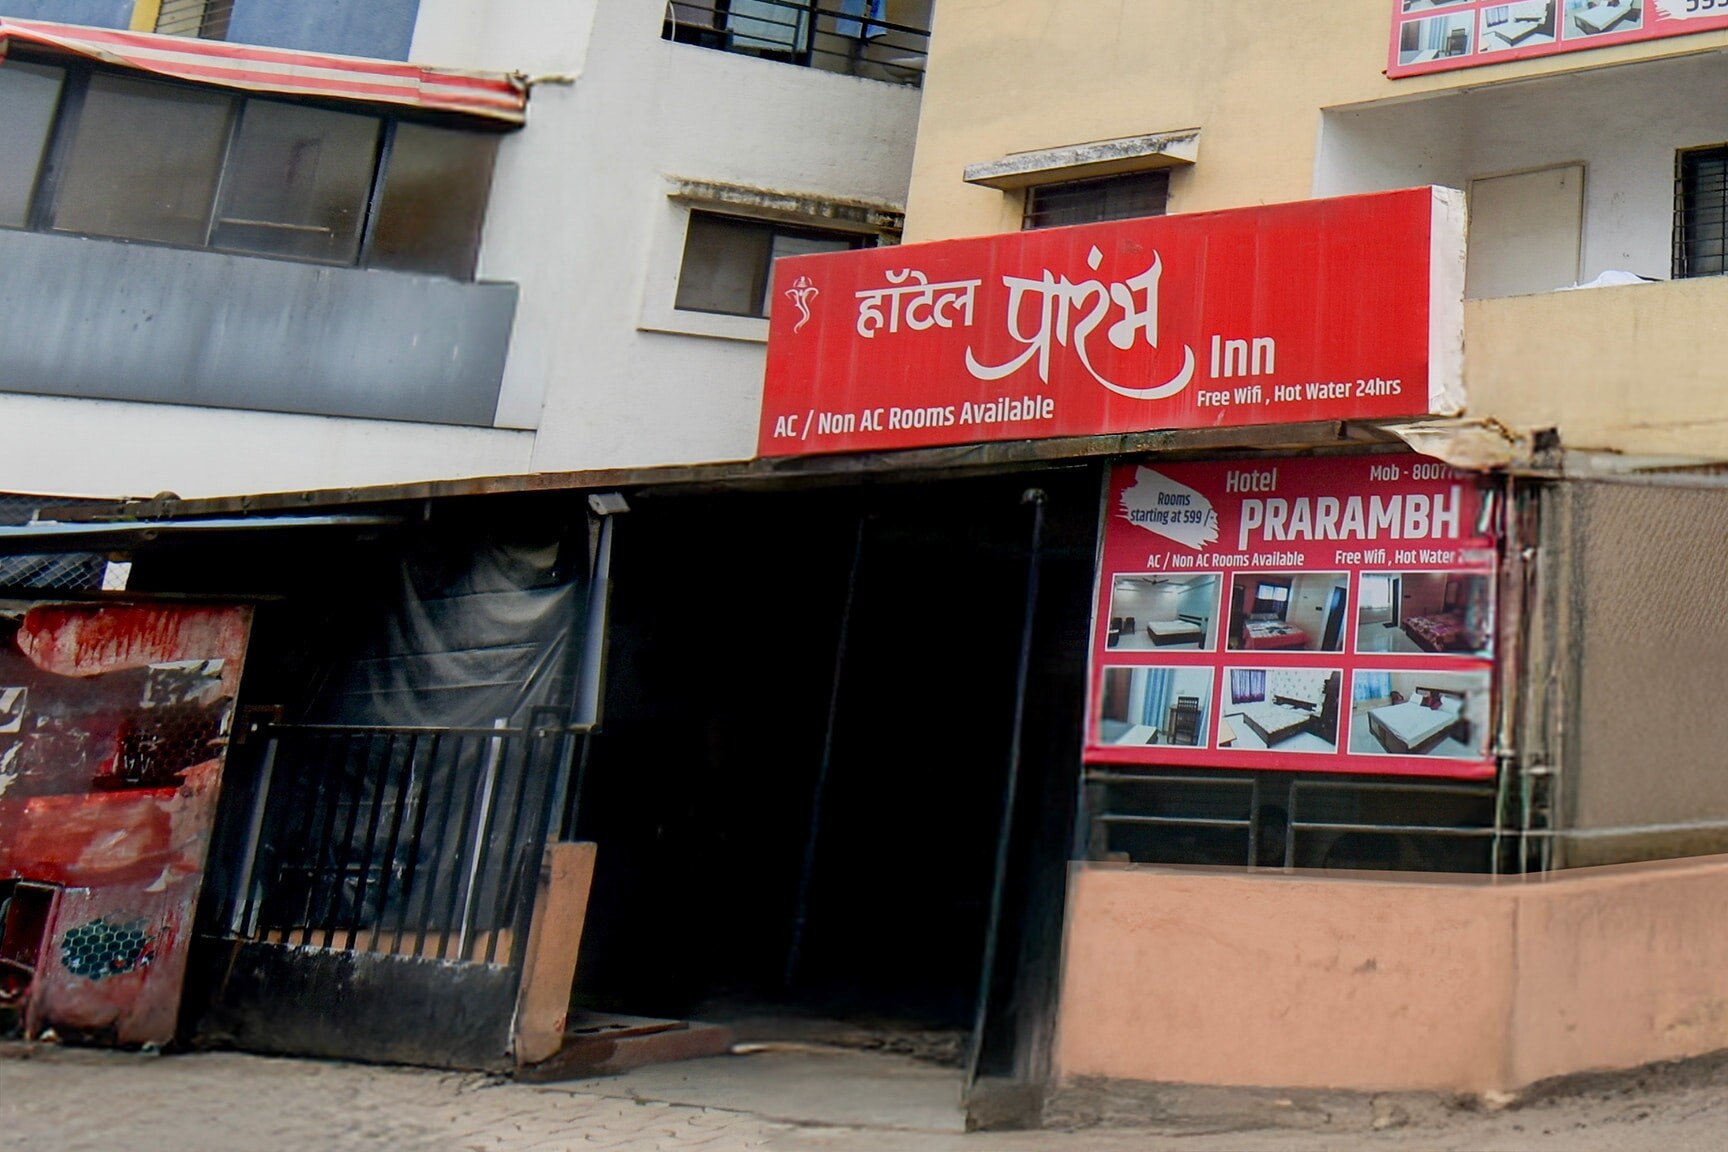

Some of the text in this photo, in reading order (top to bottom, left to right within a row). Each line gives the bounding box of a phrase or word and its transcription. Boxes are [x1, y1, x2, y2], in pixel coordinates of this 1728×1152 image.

[855, 244, 1196, 400] हॉटेल प्रारंभ
[1210, 334, 1276, 379] Inn
[1197, 389, 1230, 407] Free
[1234, 385, 1262, 405] Wifi
[1274, 384, 1302, 403] Hot
[1305, 381, 1353, 401] Water
[1355, 377, 1402, 397] 24hrs
[773, 414, 798, 438] AC
[817, 412, 856, 435] Non
[859, 408, 885, 432] AC
[888, 405, 956, 430] Rooms
[959, 395, 1055, 425] Available
[1226, 467, 1277, 493] Hotel
[1370, 464, 1400, 481] Mob
[1157, 491, 1191, 507] Rooms
[1130, 508, 1169, 525] starting
[1170, 509, 1182, 523] at
[1183, 509, 1202, 524] 599
[1238, 484, 1462, 551] PRARAMBH
[1147, 554, 1161, 568] AC
[1172, 554, 1193, 568] Non
[1195, 553, 1210, 567] AC
[1212, 553, 1249, 567] Rooms
[1251, 551, 1304, 567] Available
[1335, 549, 1361, 565] Free
[1364, 548, 1386, 564] Wifi
[1395, 549, 1417, 564] Hot
[1419, 549, 1456, 564] Water
